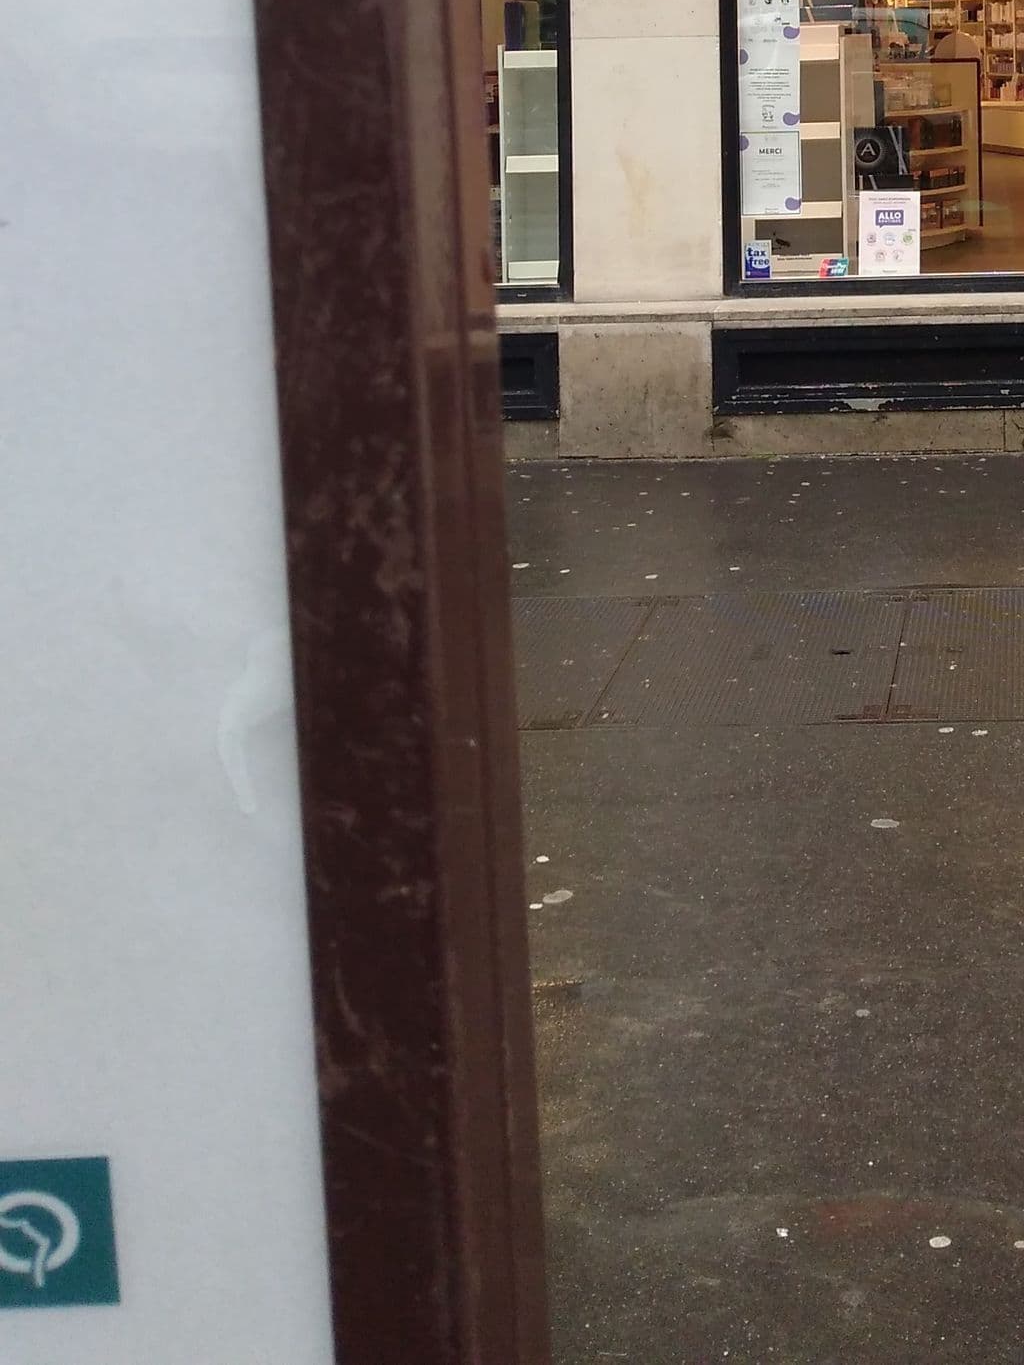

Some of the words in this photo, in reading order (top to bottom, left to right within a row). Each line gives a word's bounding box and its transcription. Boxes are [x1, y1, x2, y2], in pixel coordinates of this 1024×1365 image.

[758, 147, 783, 156] MERCI
[878, 211, 902, 220] ALLO
[747, 247, 767, 257] tax
[749, 256, 770, 270] free
